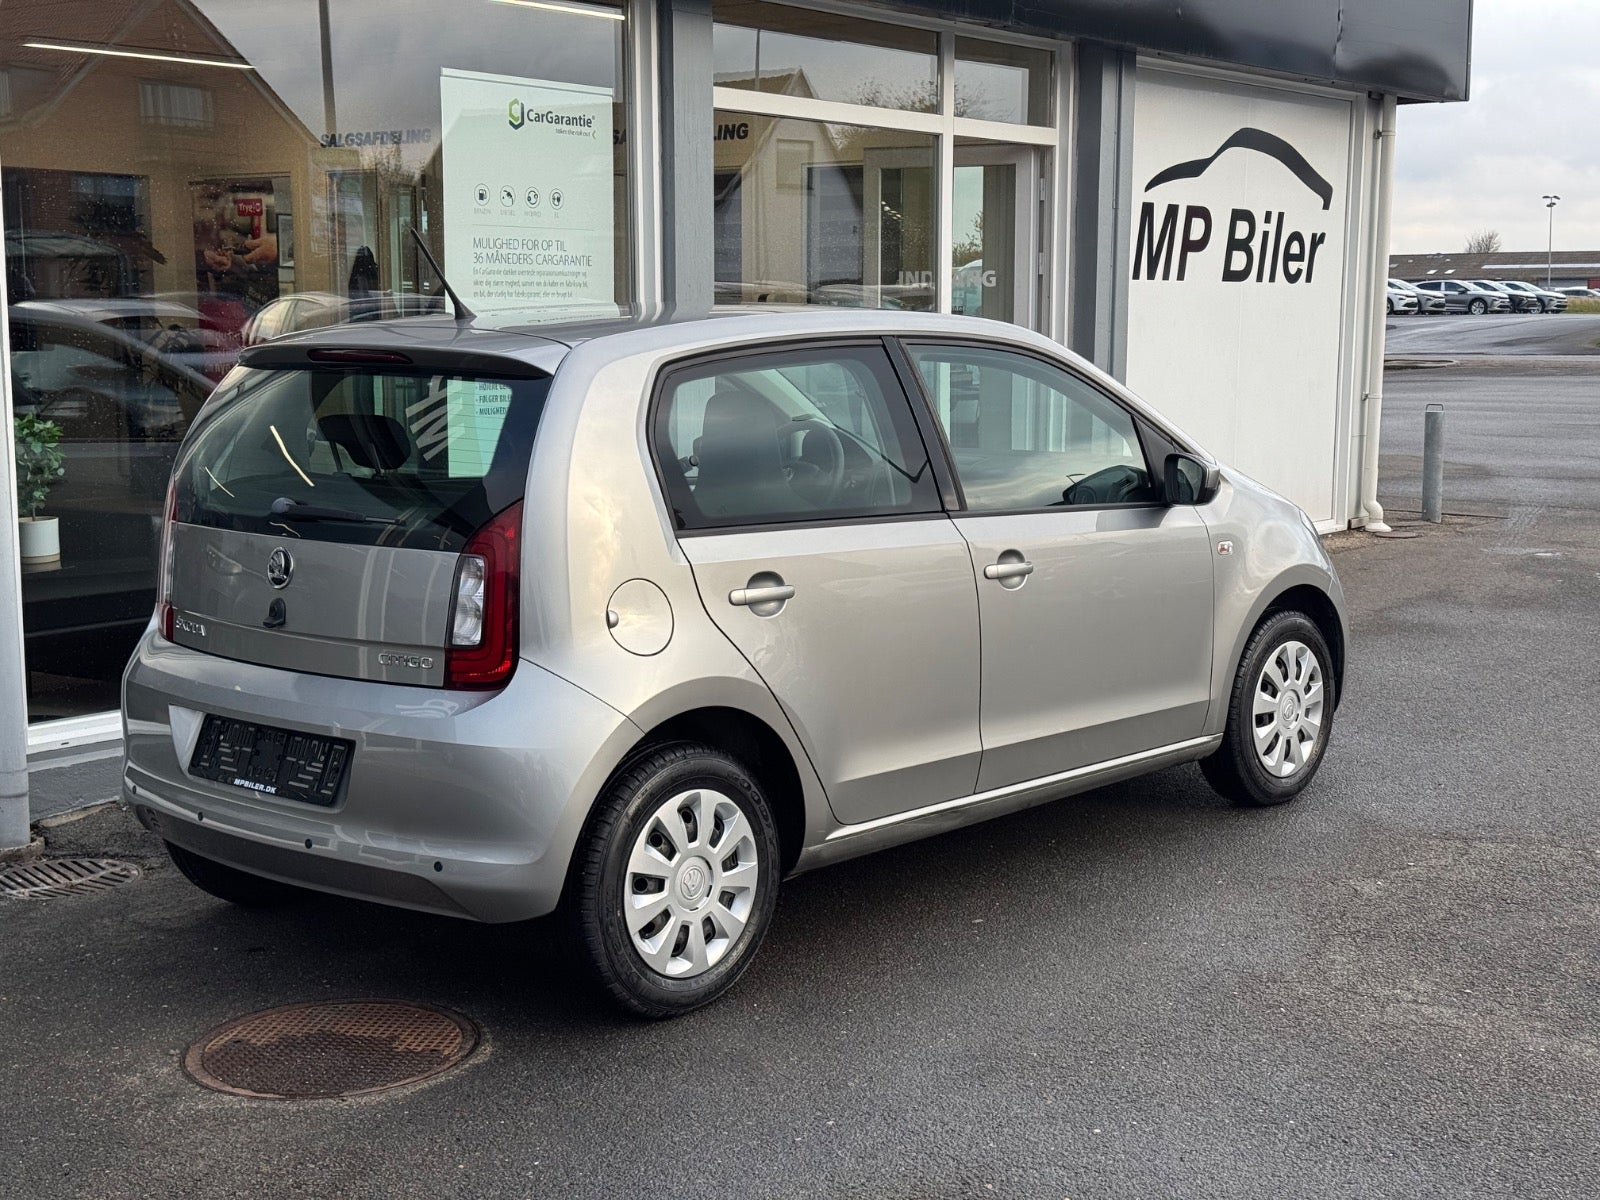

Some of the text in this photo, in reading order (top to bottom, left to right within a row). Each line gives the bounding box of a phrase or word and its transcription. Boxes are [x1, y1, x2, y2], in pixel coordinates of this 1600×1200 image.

[526, 108, 593, 128] CarGarantie
[320, 128, 431, 148] SALGSAFDELING
[473, 237, 567, 252] MULIGHED FOR OP TIL
[1132, 201, 1327, 284] MP Biler
[473, 250, 593, 267] 36 MÅNEDERS CARGARANTIE
[378, 652, 434, 669] CITIGO
[233, 777, 278, 795] MPBILER.DK
